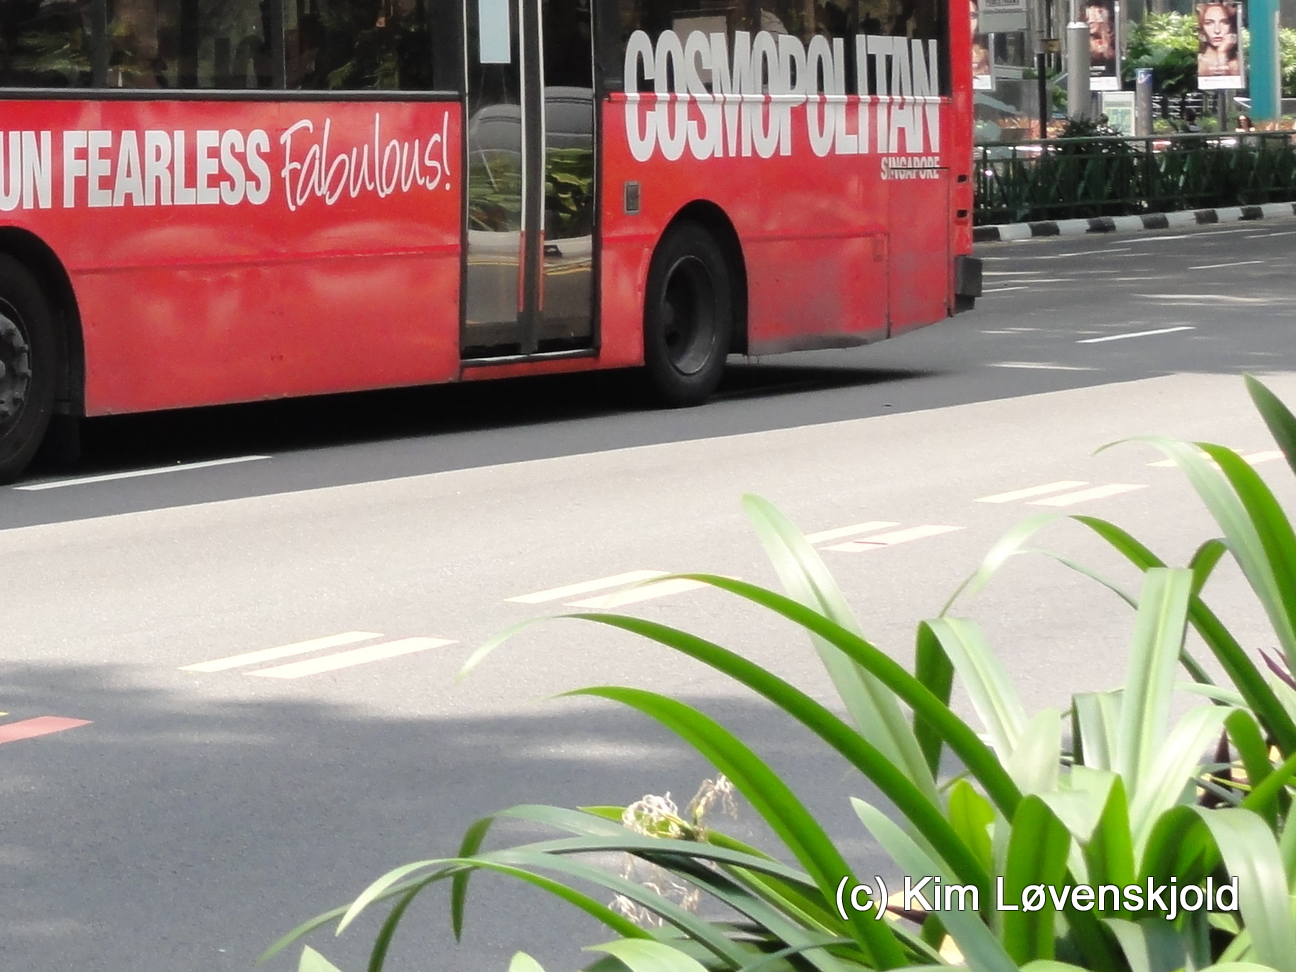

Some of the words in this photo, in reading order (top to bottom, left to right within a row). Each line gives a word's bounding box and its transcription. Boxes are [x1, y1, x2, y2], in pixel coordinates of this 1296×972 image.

[624, 30, 940, 162] COSMOPOLITAN
[63, 129, 272, 208] FEARLESS
[279, 111, 451, 212] Fabulous!
[881, 156, 940, 180] SINGAPORE
